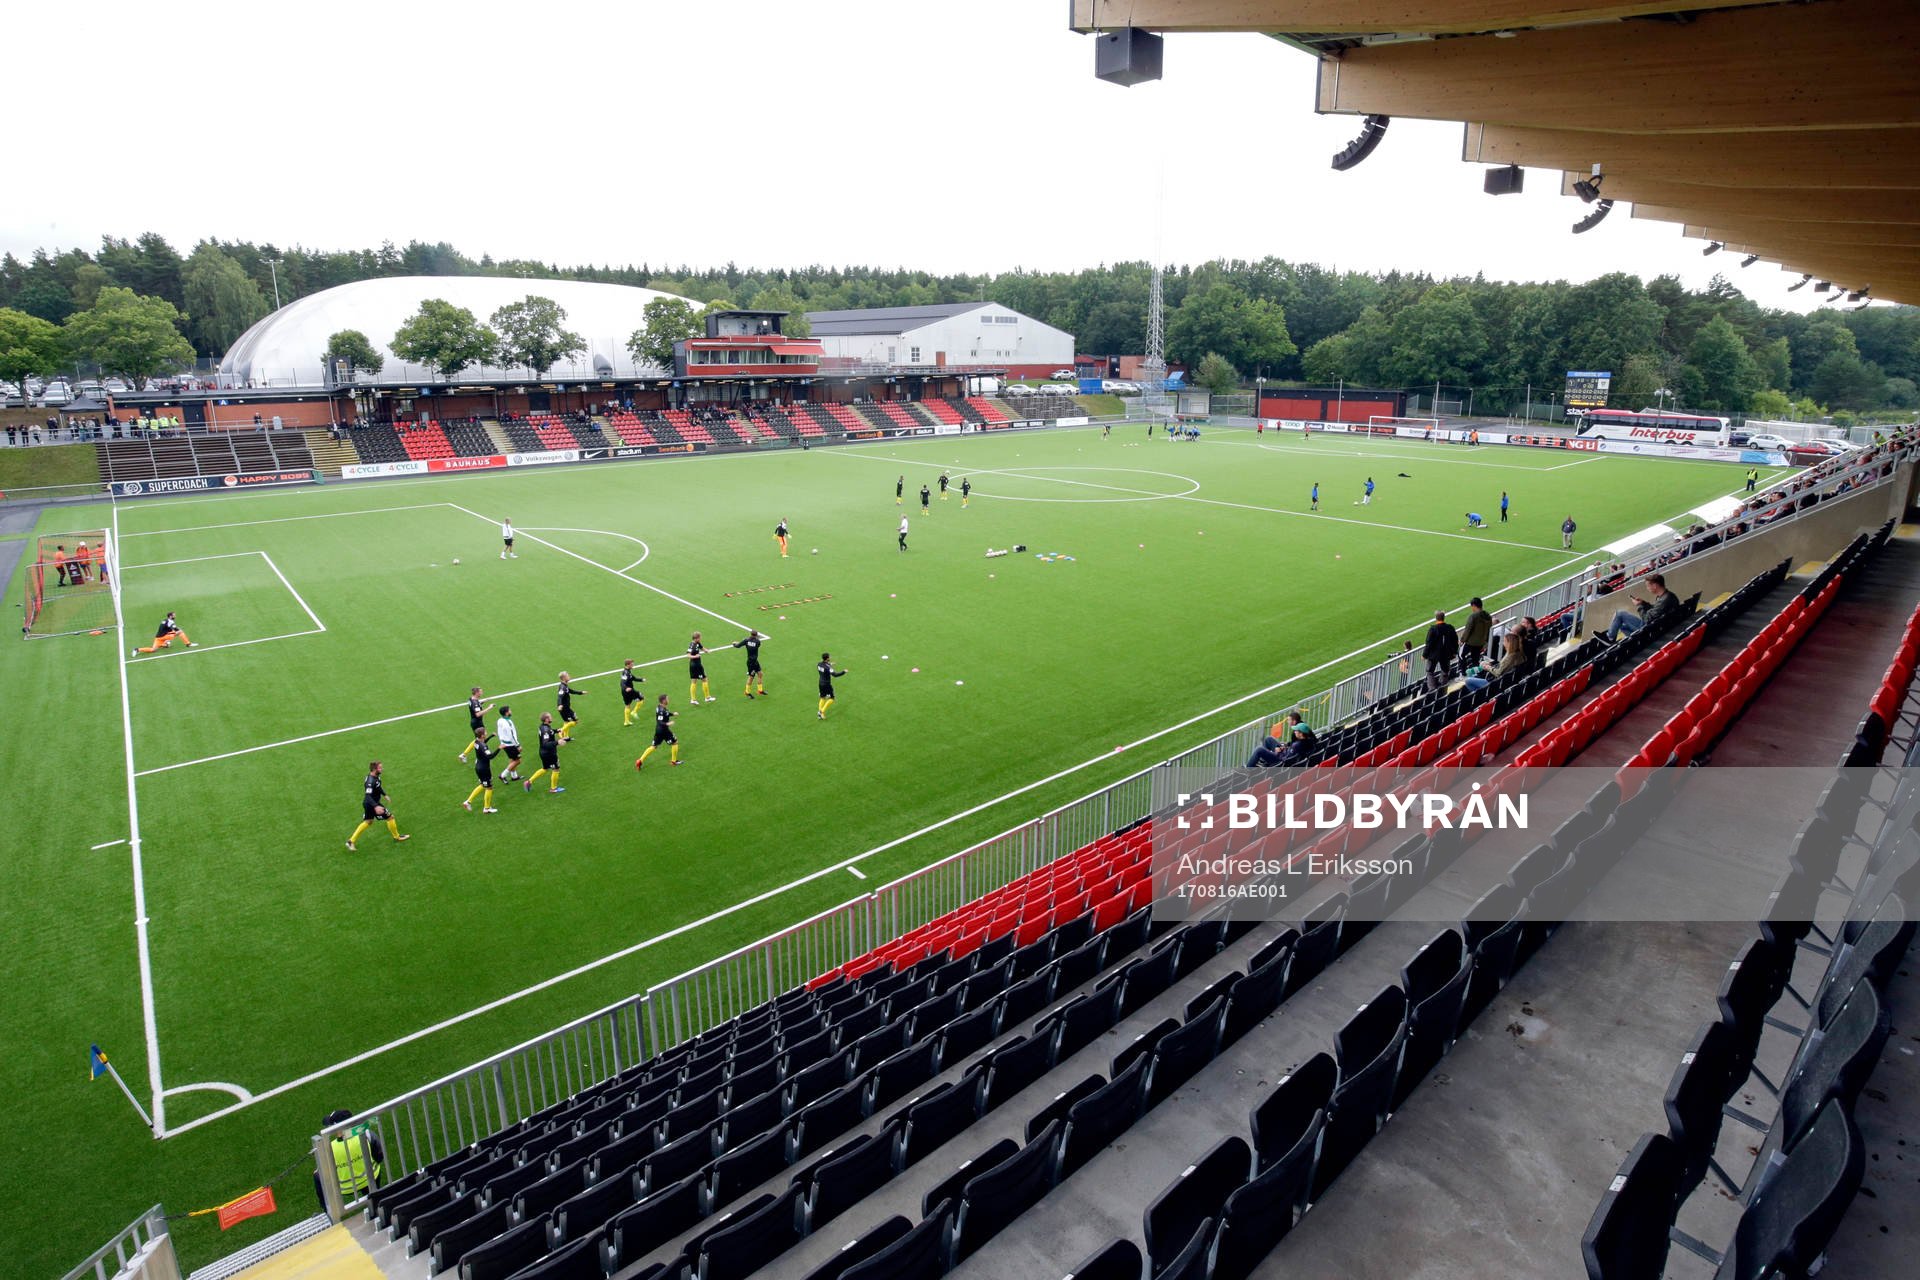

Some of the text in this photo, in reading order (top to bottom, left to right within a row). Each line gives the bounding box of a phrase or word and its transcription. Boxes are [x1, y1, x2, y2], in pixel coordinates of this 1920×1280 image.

[1629, 427, 1696, 440] Interbus
[617, 447, 642, 456] stadium
[525, 454, 562, 462] Volkswagen
[395, 463, 419, 471] CYCLE
[446, 458, 491, 468] BAUHAUS
[356, 465, 381, 474] CYCLE
[240, 475, 277, 483] HAPPY
[149, 478, 208, 492] SUPERCOACH
